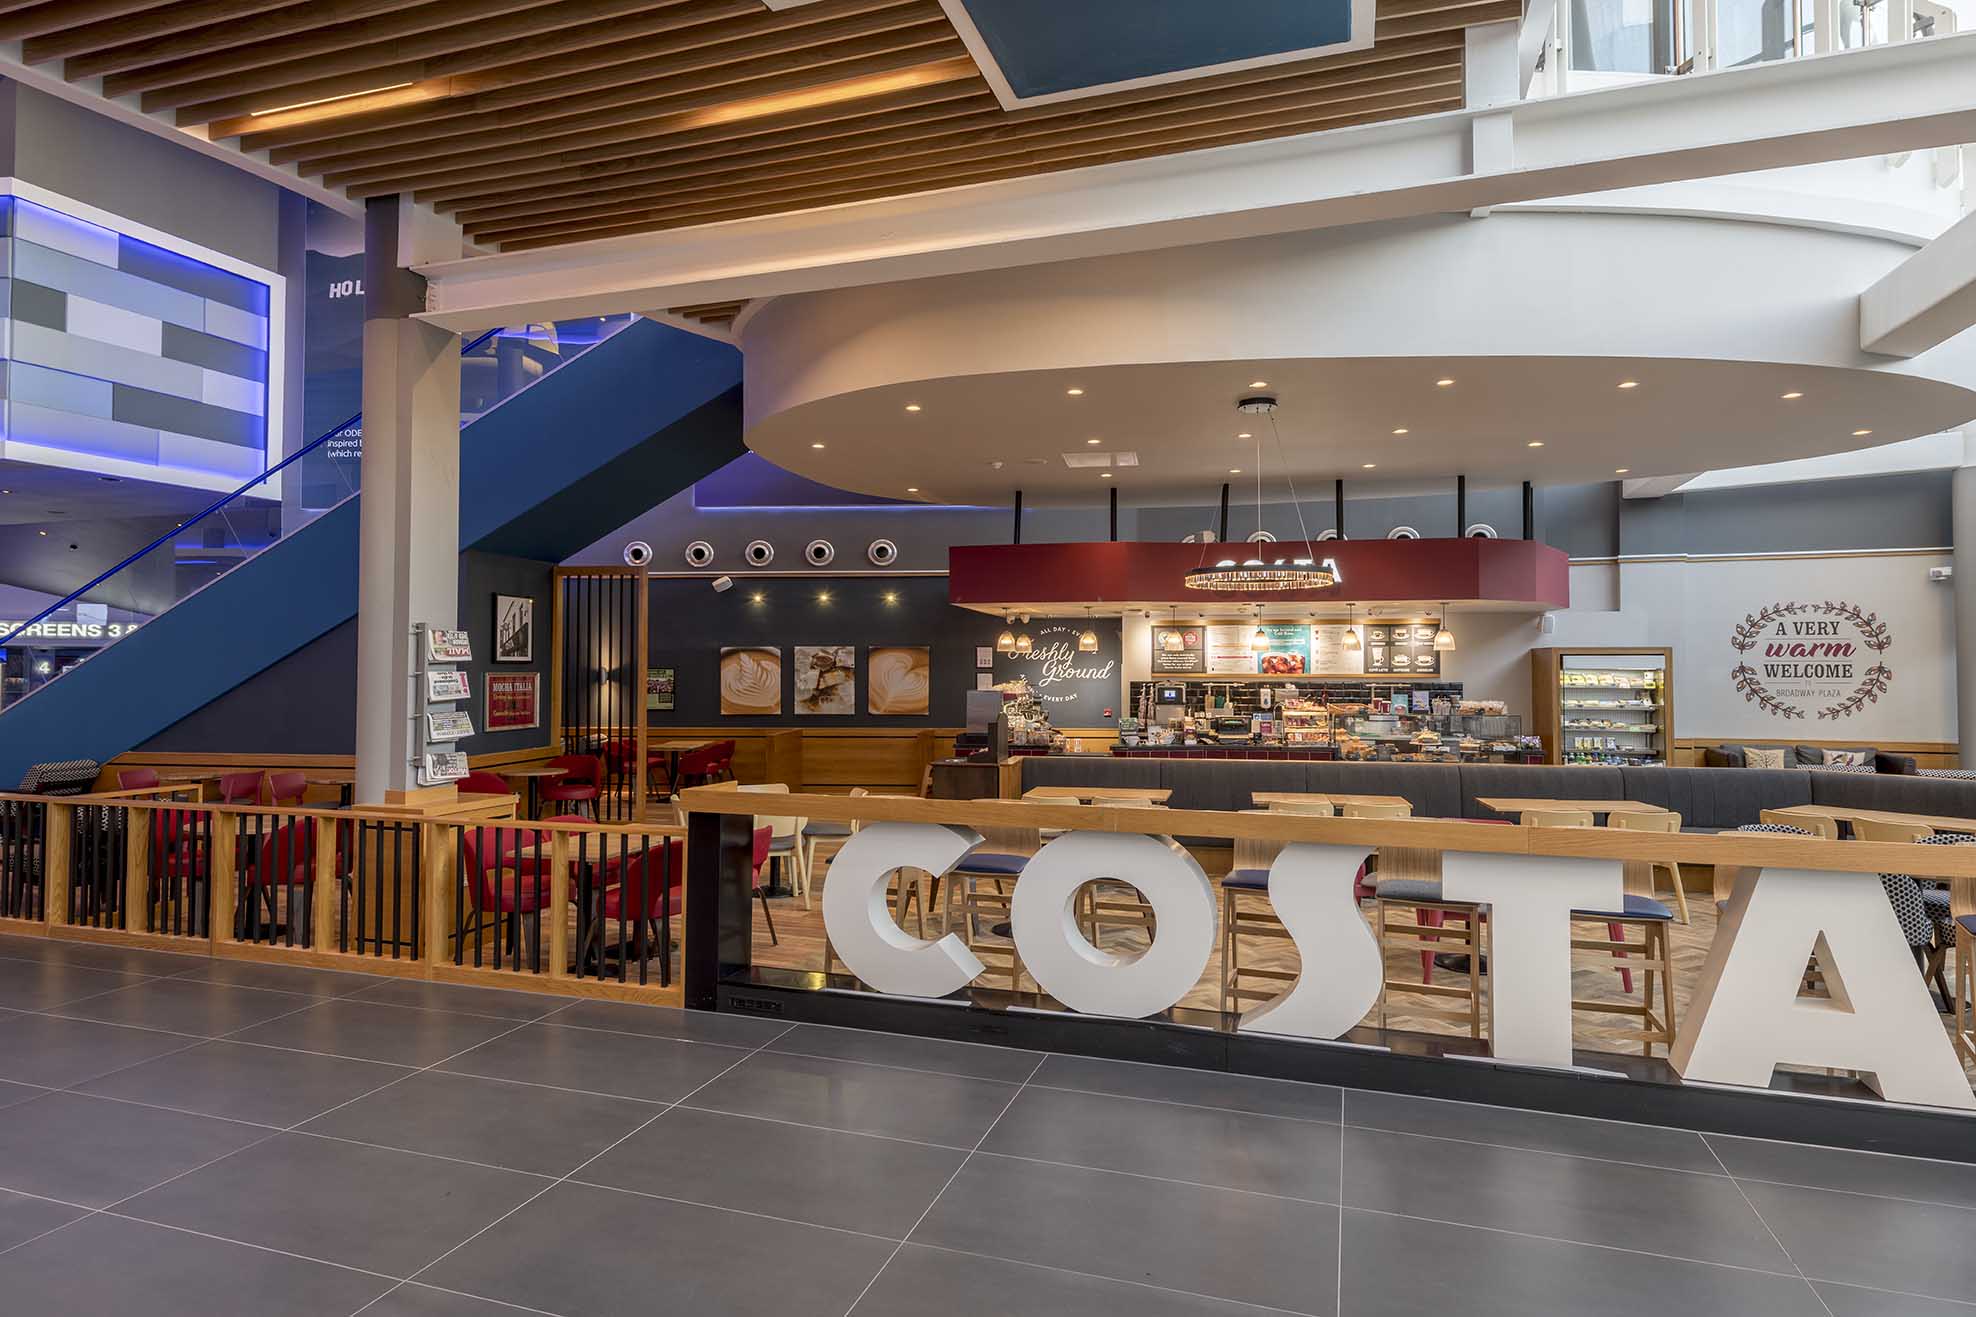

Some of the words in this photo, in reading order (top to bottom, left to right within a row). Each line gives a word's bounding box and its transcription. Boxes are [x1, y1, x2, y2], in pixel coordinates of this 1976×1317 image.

[327, 440, 358, 448] inspired
[327, 449, 352, 458] (which
[108, 624, 121, 637] 3
[1040, 628, 1052, 636] ALL
[1775, 621, 1787, 635] A
[1793, 621, 1840, 635] VERY
[1008, 639, 1075, 669] reshly
[1765, 642, 1857, 657] warm
[1039, 660, 1114, 687] Ground
[1763, 663, 1853, 678] WELCOME
[1043, 694, 1063, 702] EVERY
[1065, 692, 1078, 702] DAY
[1776, 688, 1815, 697] BROADWAY
[1819, 688, 1841, 697] PLAZA
[822, 822, 1976, 1111] COSTA
